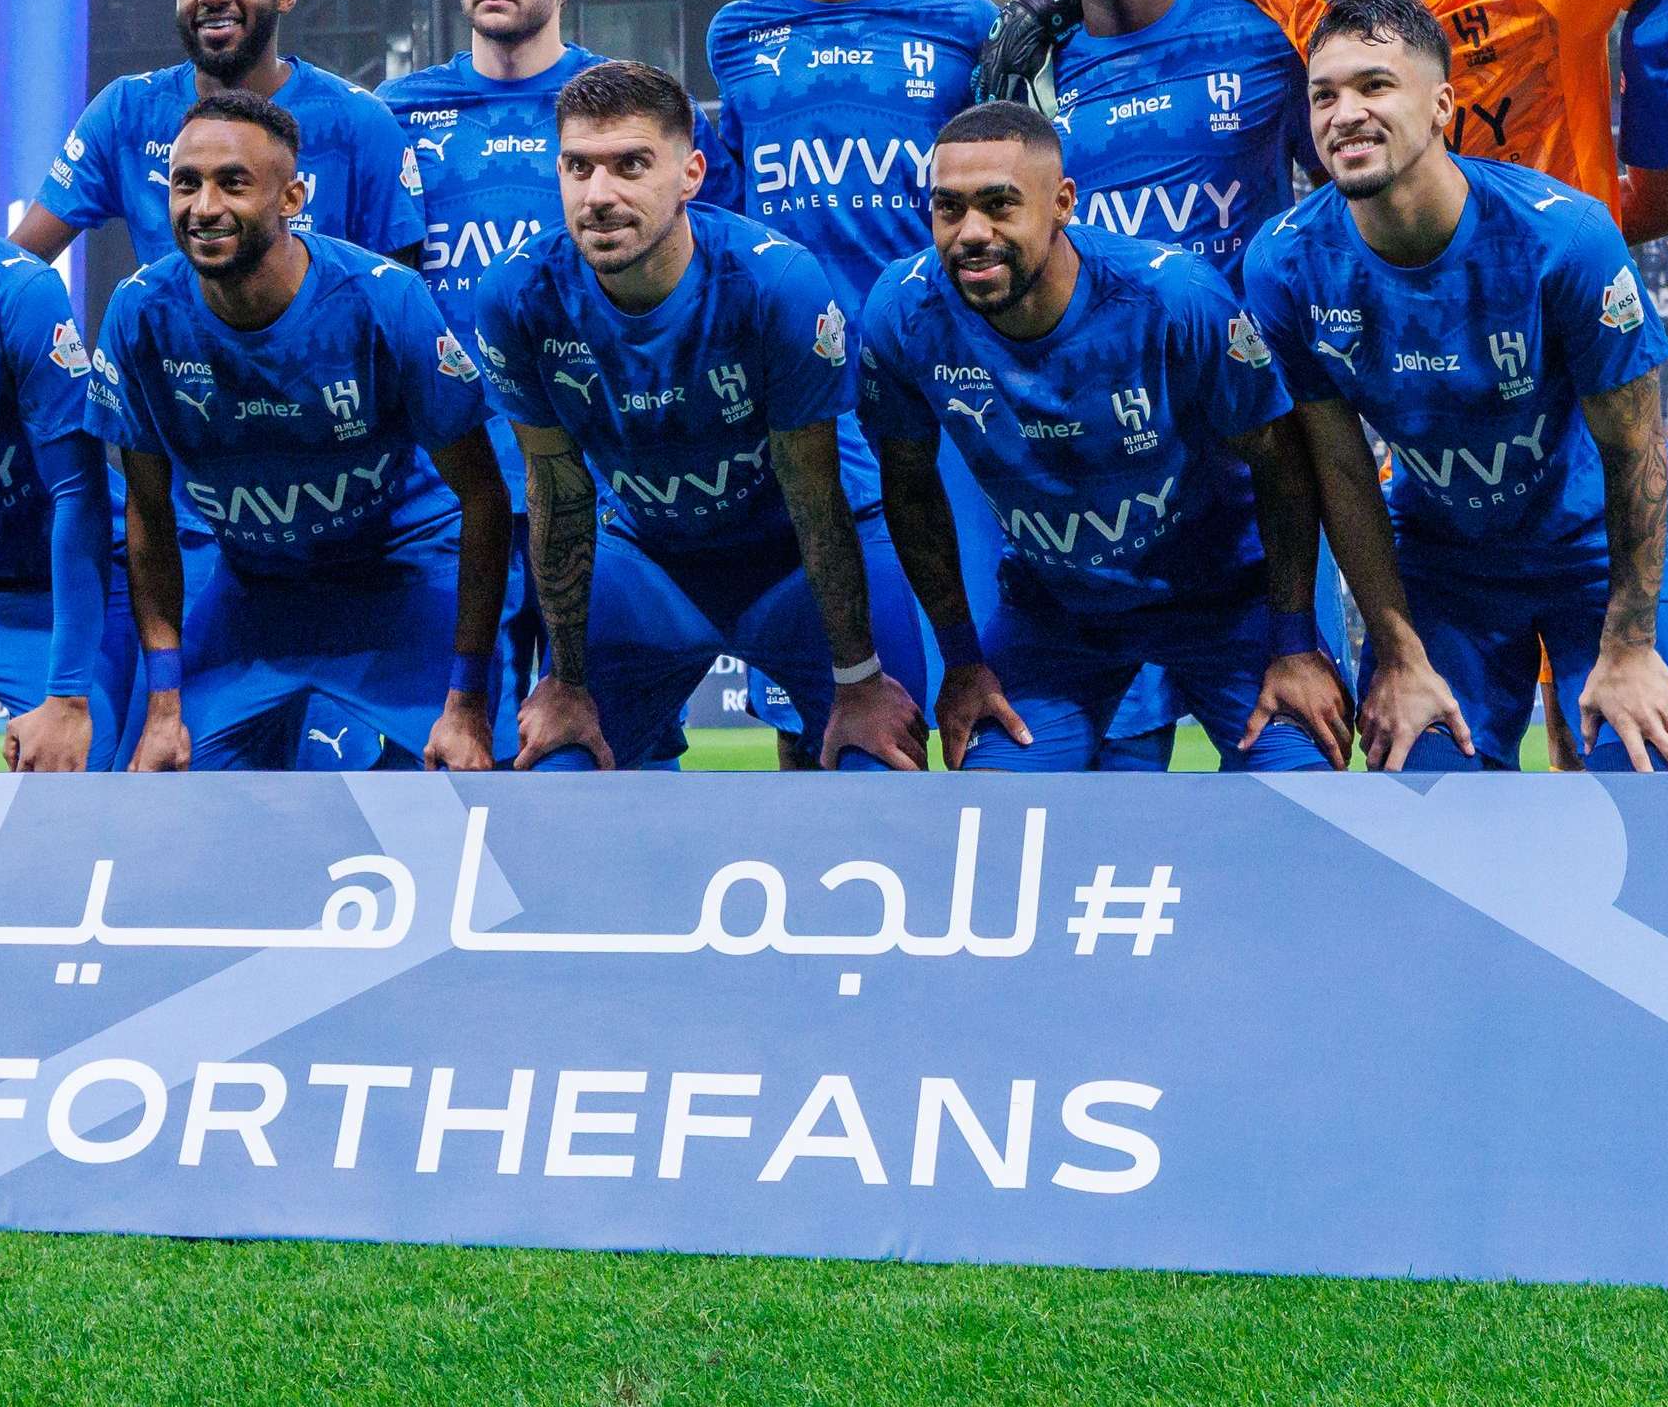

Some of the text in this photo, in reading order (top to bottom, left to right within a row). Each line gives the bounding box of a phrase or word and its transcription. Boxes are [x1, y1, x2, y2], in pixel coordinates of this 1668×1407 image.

[410, 109, 458, 125] flynas
[1057, 88, 1079, 105] nas
[145, 140, 172, 158] flyn
[754, 138, 934, 193] SAVVY
[763, 194, 932, 215] GAMES GROU
[1087, 180, 1241, 236] AVVY
[423, 220, 541, 270] SAV
[1193, 238, 1242, 255] OUP
[1310, 304, 1362, 325] flynas
[163, 359, 212, 377] flynas
[543, 339, 591, 357] flyna
[613, 437, 769, 504] AVVY
[1390, 413, 1546, 488] AVVY
[187, 453, 390, 525] SAVVY
[312, 480, 396, 535] GROUP
[694, 472, 765, 515] GROU
[1011, 476, 1174, 553] AVVY
[1090, 511, 1182, 566] GROUP
